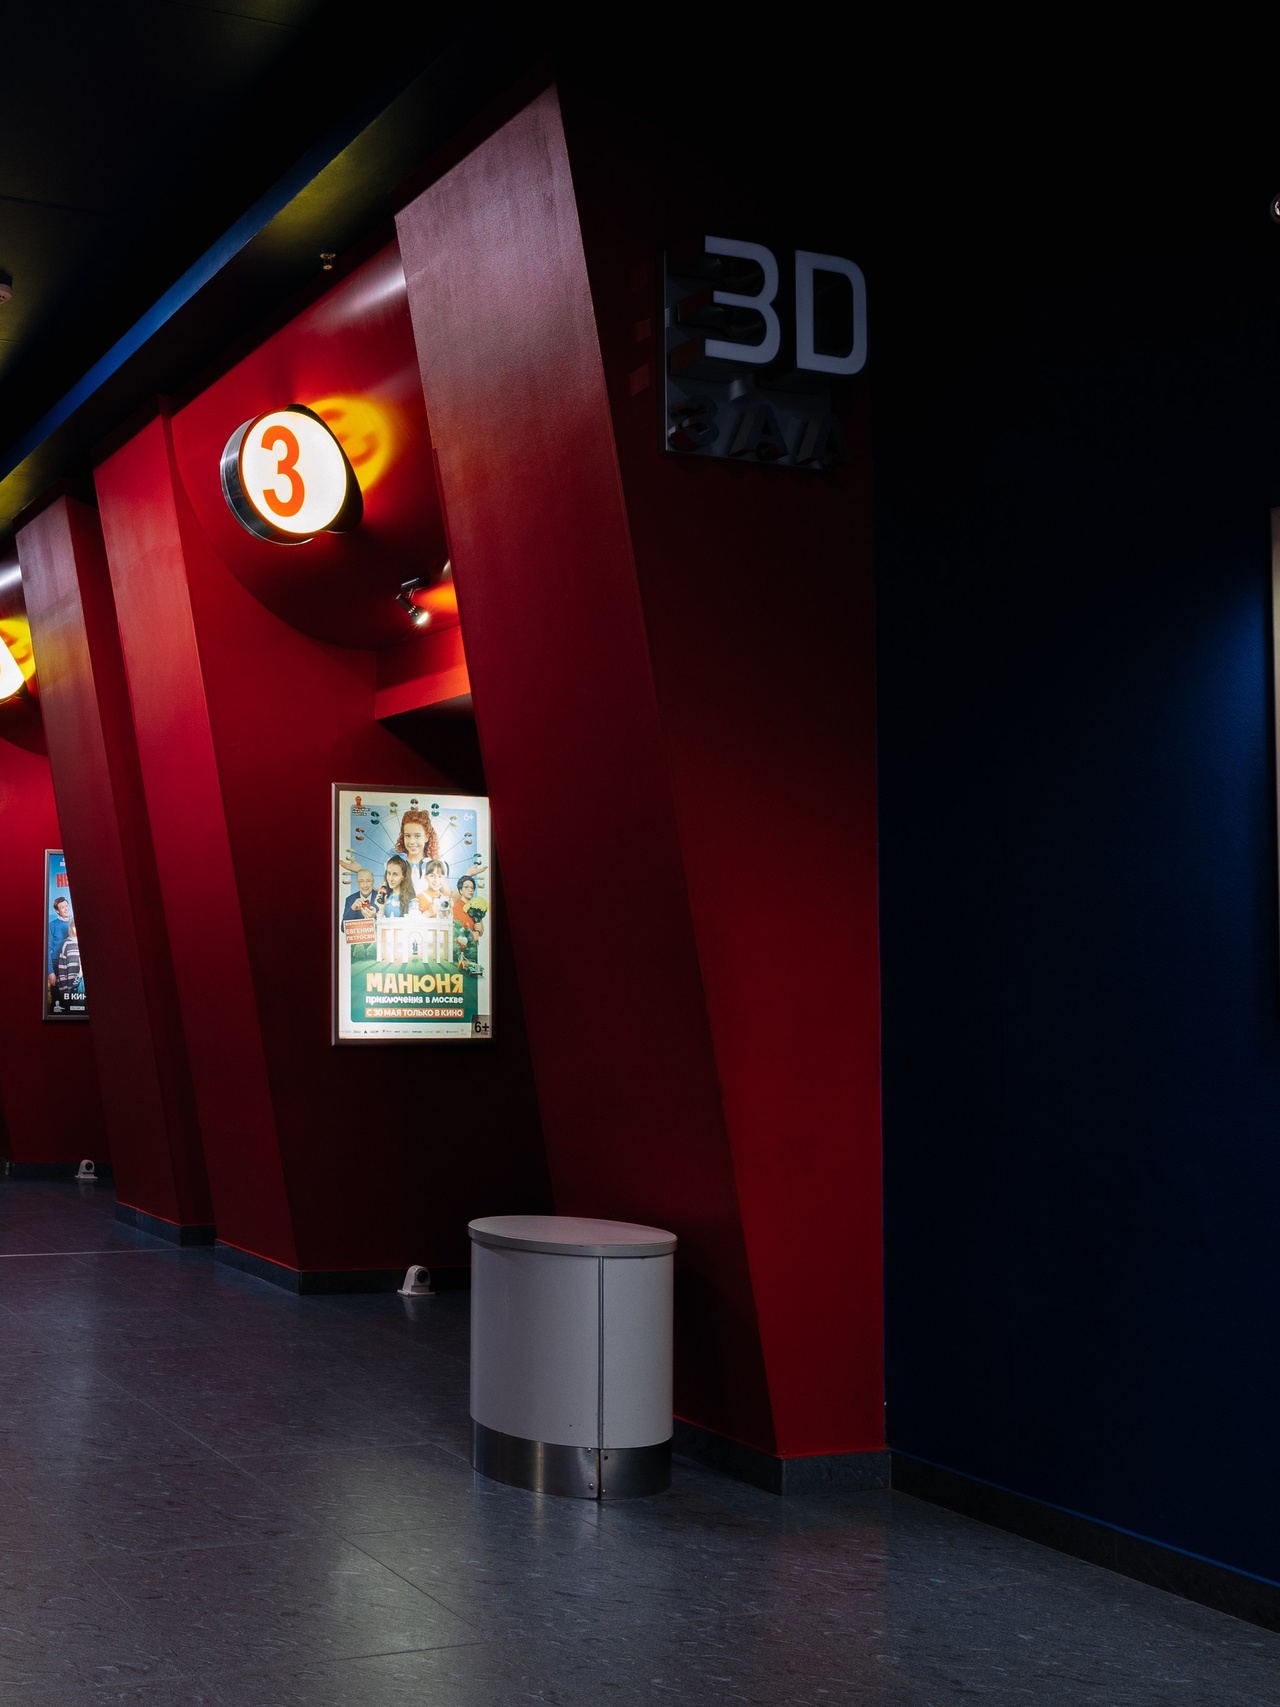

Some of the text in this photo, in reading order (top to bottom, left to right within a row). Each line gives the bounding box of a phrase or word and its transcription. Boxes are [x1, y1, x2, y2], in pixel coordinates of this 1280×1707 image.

[705, 235, 867, 375] 3D
[261, 425, 305, 517] 3
[366, 973, 464, 994] МАНЮНЯ
[432, 996, 464, 1004] москве
[402, 1009, 434, 1017] ТОЛЬКО
[442, 1009, 463, 1017] КИНО
[474, 1021, 490, 1033] 6+
